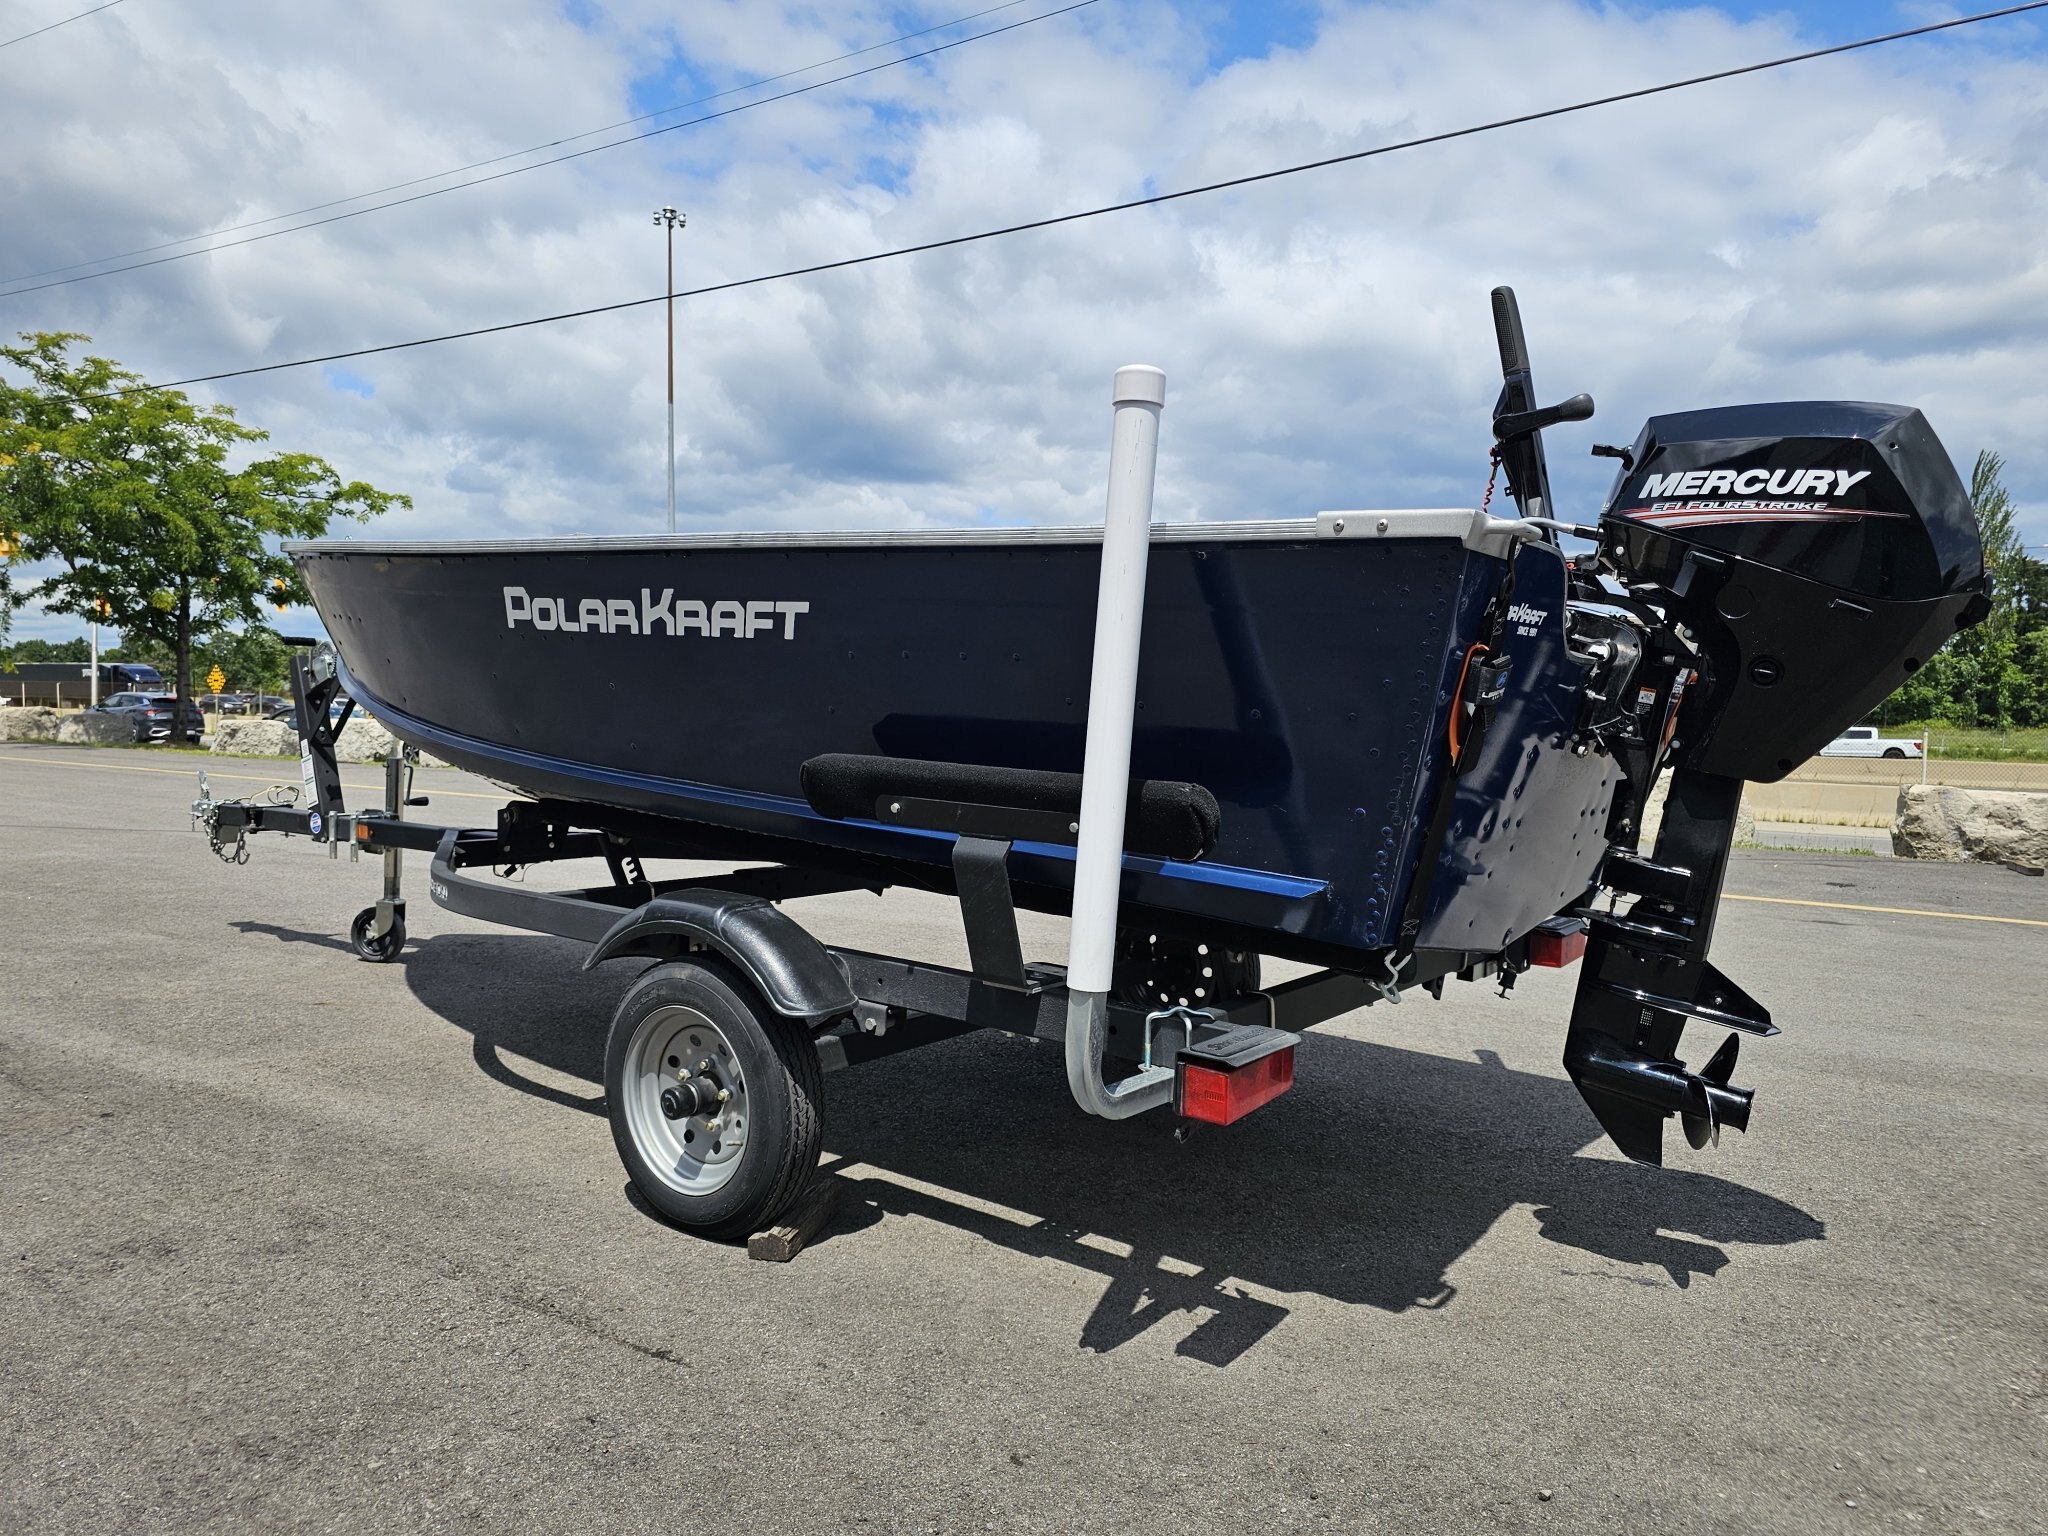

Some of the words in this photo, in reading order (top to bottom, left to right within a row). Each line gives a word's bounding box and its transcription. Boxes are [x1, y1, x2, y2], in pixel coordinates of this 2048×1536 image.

[1638, 469, 1872, 499] MERCURY
[1650, 501, 1681, 512] EFI
[1685, 499, 1828, 511] FOURSTROKE
